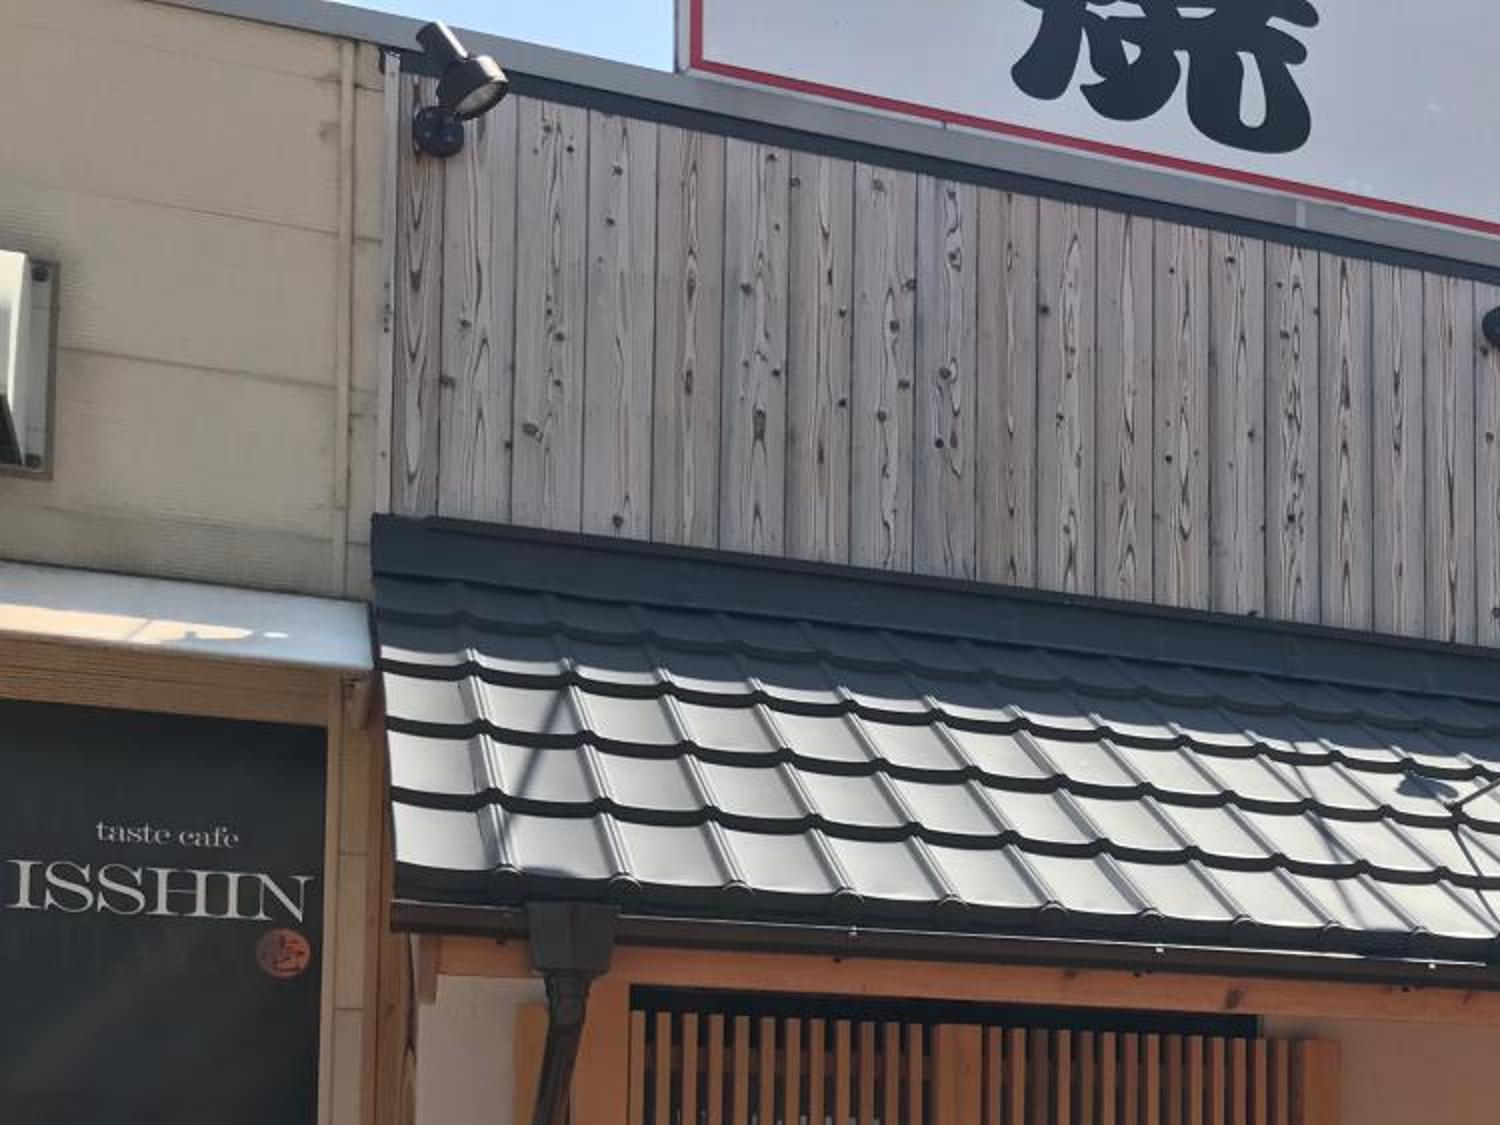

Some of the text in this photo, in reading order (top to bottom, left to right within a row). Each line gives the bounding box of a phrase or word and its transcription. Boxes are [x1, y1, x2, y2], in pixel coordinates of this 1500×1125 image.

[96, 820, 241, 850] taste cafe
[4, 857, 316, 925] ISSHIN
